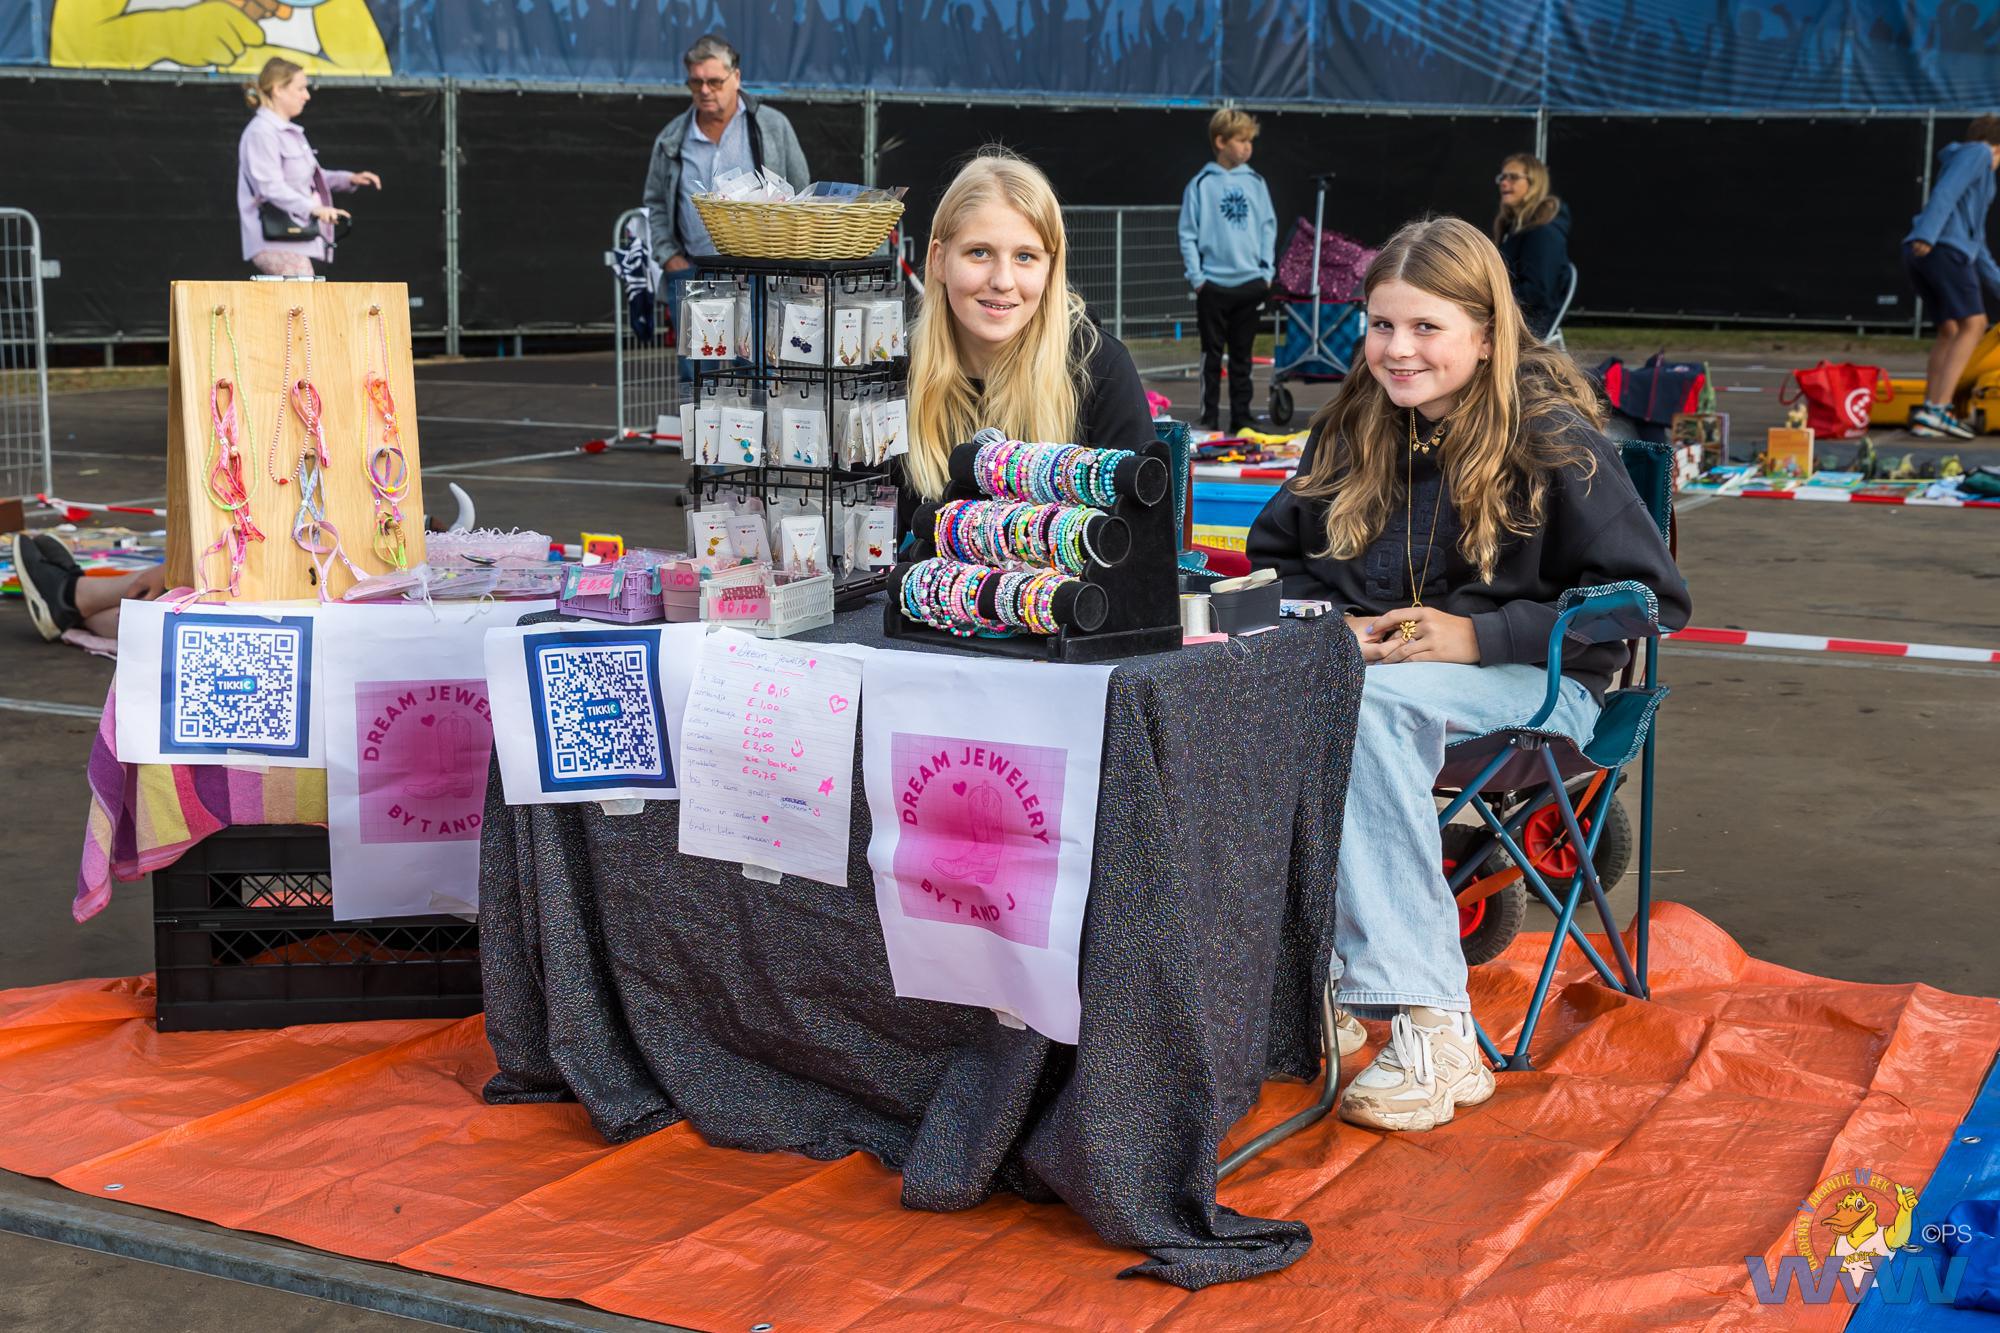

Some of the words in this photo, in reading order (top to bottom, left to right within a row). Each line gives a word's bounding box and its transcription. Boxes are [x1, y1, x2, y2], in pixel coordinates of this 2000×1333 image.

[363, 691, 418, 762] DREAM
[425, 685, 493, 724] JEWEL
[387, 804, 416, 826] BY
[420, 819, 432, 833] T
[438, 813, 482, 834] AND
[902, 750, 951, 826] DREAM
[959, 746, 1049, 846] JEWELERY
[920, 878, 946, 903] BY
[951, 898, 962, 914] T
[970, 904, 1000, 922] AND
[1005, 892, 1016, 911] J
